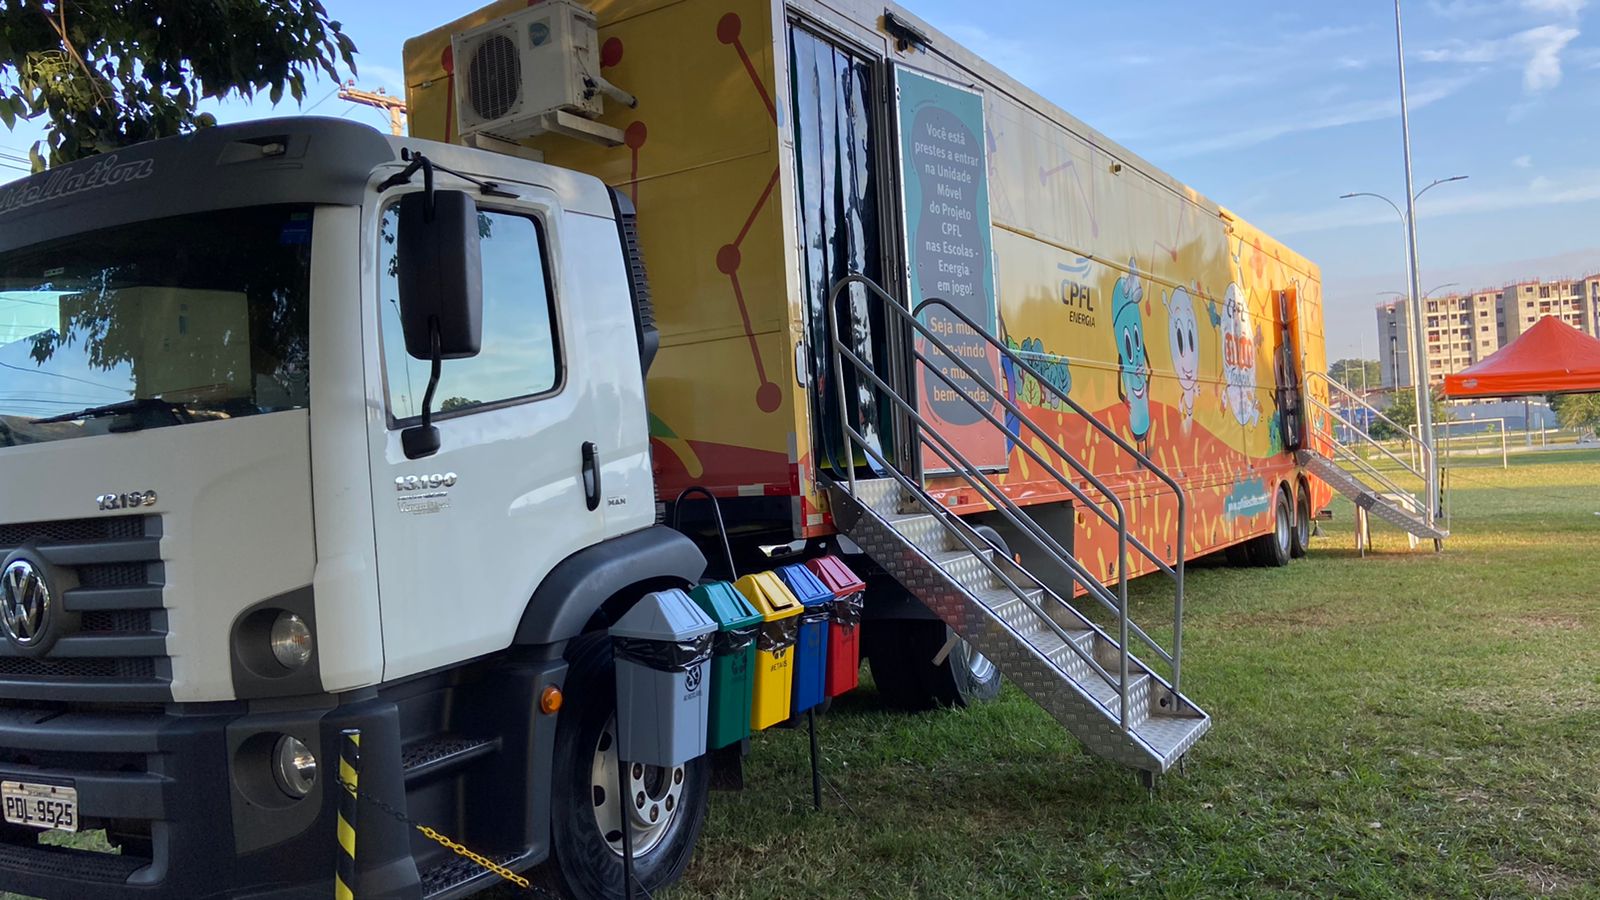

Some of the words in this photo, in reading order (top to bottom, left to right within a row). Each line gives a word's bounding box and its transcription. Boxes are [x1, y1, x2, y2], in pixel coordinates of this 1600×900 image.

[926, 122, 947, 140] Você
[948, 131, 966, 145] está
[914, 141, 946, 160] prestes
[947, 150, 953, 161] a
[954, 153, 979, 167] entrar
[925, 163, 936, 175] na
[937, 165, 972, 184] Unidade
[937, 182, 962, 201] Móvel
[929, 200, 940, 215] do
[942, 203, 972, 221] Projeto
[941, 222, 962, 238] CPFL
[925, 240, 941, 253] nas
[943, 241, 974, 258] Escolas
[938, 259, 970, 278] Energia
[937, 281, 950, 292] em
[951, 280, 973, 297] jogo!
[1060, 279, 1094, 312] CPFL
[930, 317, 953, 337] Seja
[1069, 310, 1096, 328] ENERGIA
[395, 472, 457, 491] 13.190
